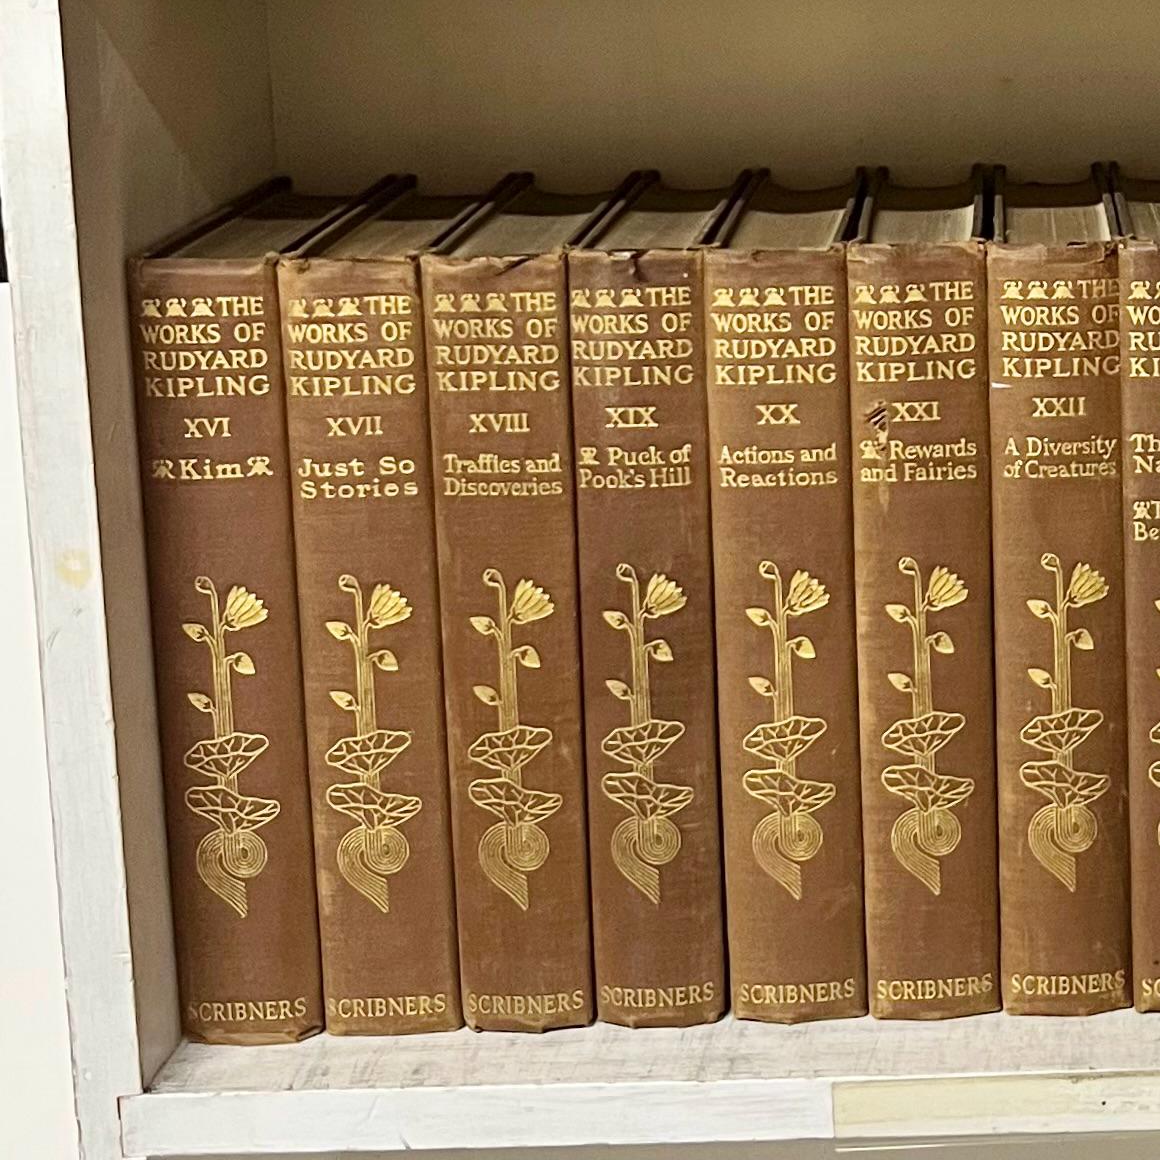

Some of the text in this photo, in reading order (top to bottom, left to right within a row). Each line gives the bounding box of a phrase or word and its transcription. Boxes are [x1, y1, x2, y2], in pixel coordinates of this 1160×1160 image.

[788, 286, 834, 306] THE
[710, 311, 834, 333] WORKS OF
[713, 338, 836, 359] RUDYARD
[715, 364, 836, 385] KIPLING
[469, 413, 530, 433] XVIII
[756, 404, 800, 425] XX
[606, 444, 691, 466] Puck of
[716, 443, 836, 465] Actions and
[890, 438, 976, 460] Rewards
[1005, 436, 1117, 459] A Diversity
[179, 459, 244, 480] Kim
[297, 456, 415, 477] Just So
[443, 453, 562, 474] Traffics and
[860, 462, 977, 482] and Fairies
[1002, 460, 1116, 478] of Creatures
[443, 477, 562, 496] Discoveries
[649, 467, 691, 488] Hill
[719, 467, 838, 487] Reactions
[300, 478, 418, 499] Stories
[738, 978, 855, 1004] SCRIBNERS
